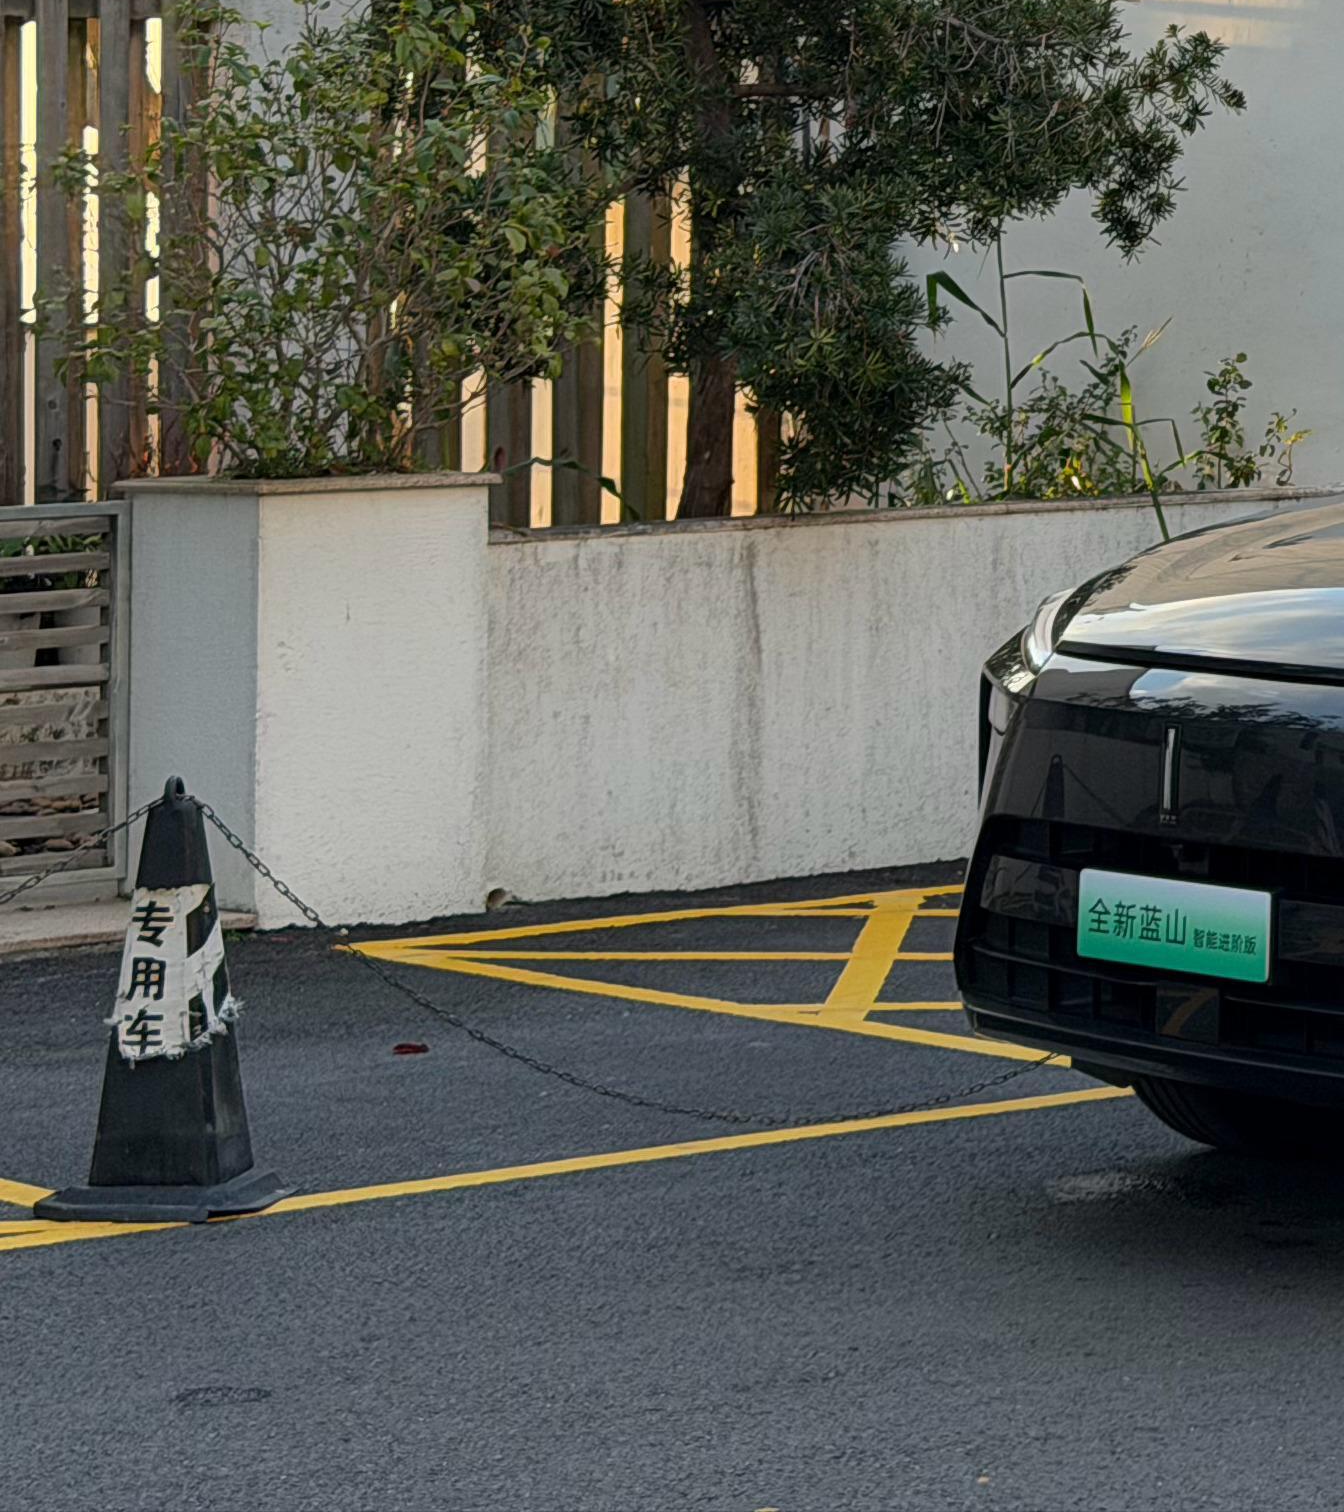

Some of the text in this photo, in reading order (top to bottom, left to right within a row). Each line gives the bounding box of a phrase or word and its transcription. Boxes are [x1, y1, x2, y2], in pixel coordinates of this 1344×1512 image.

[122, 900, 175, 1054] 专用车
[1088, 898, 1257, 956] 全新蓝山 智能进阶版
